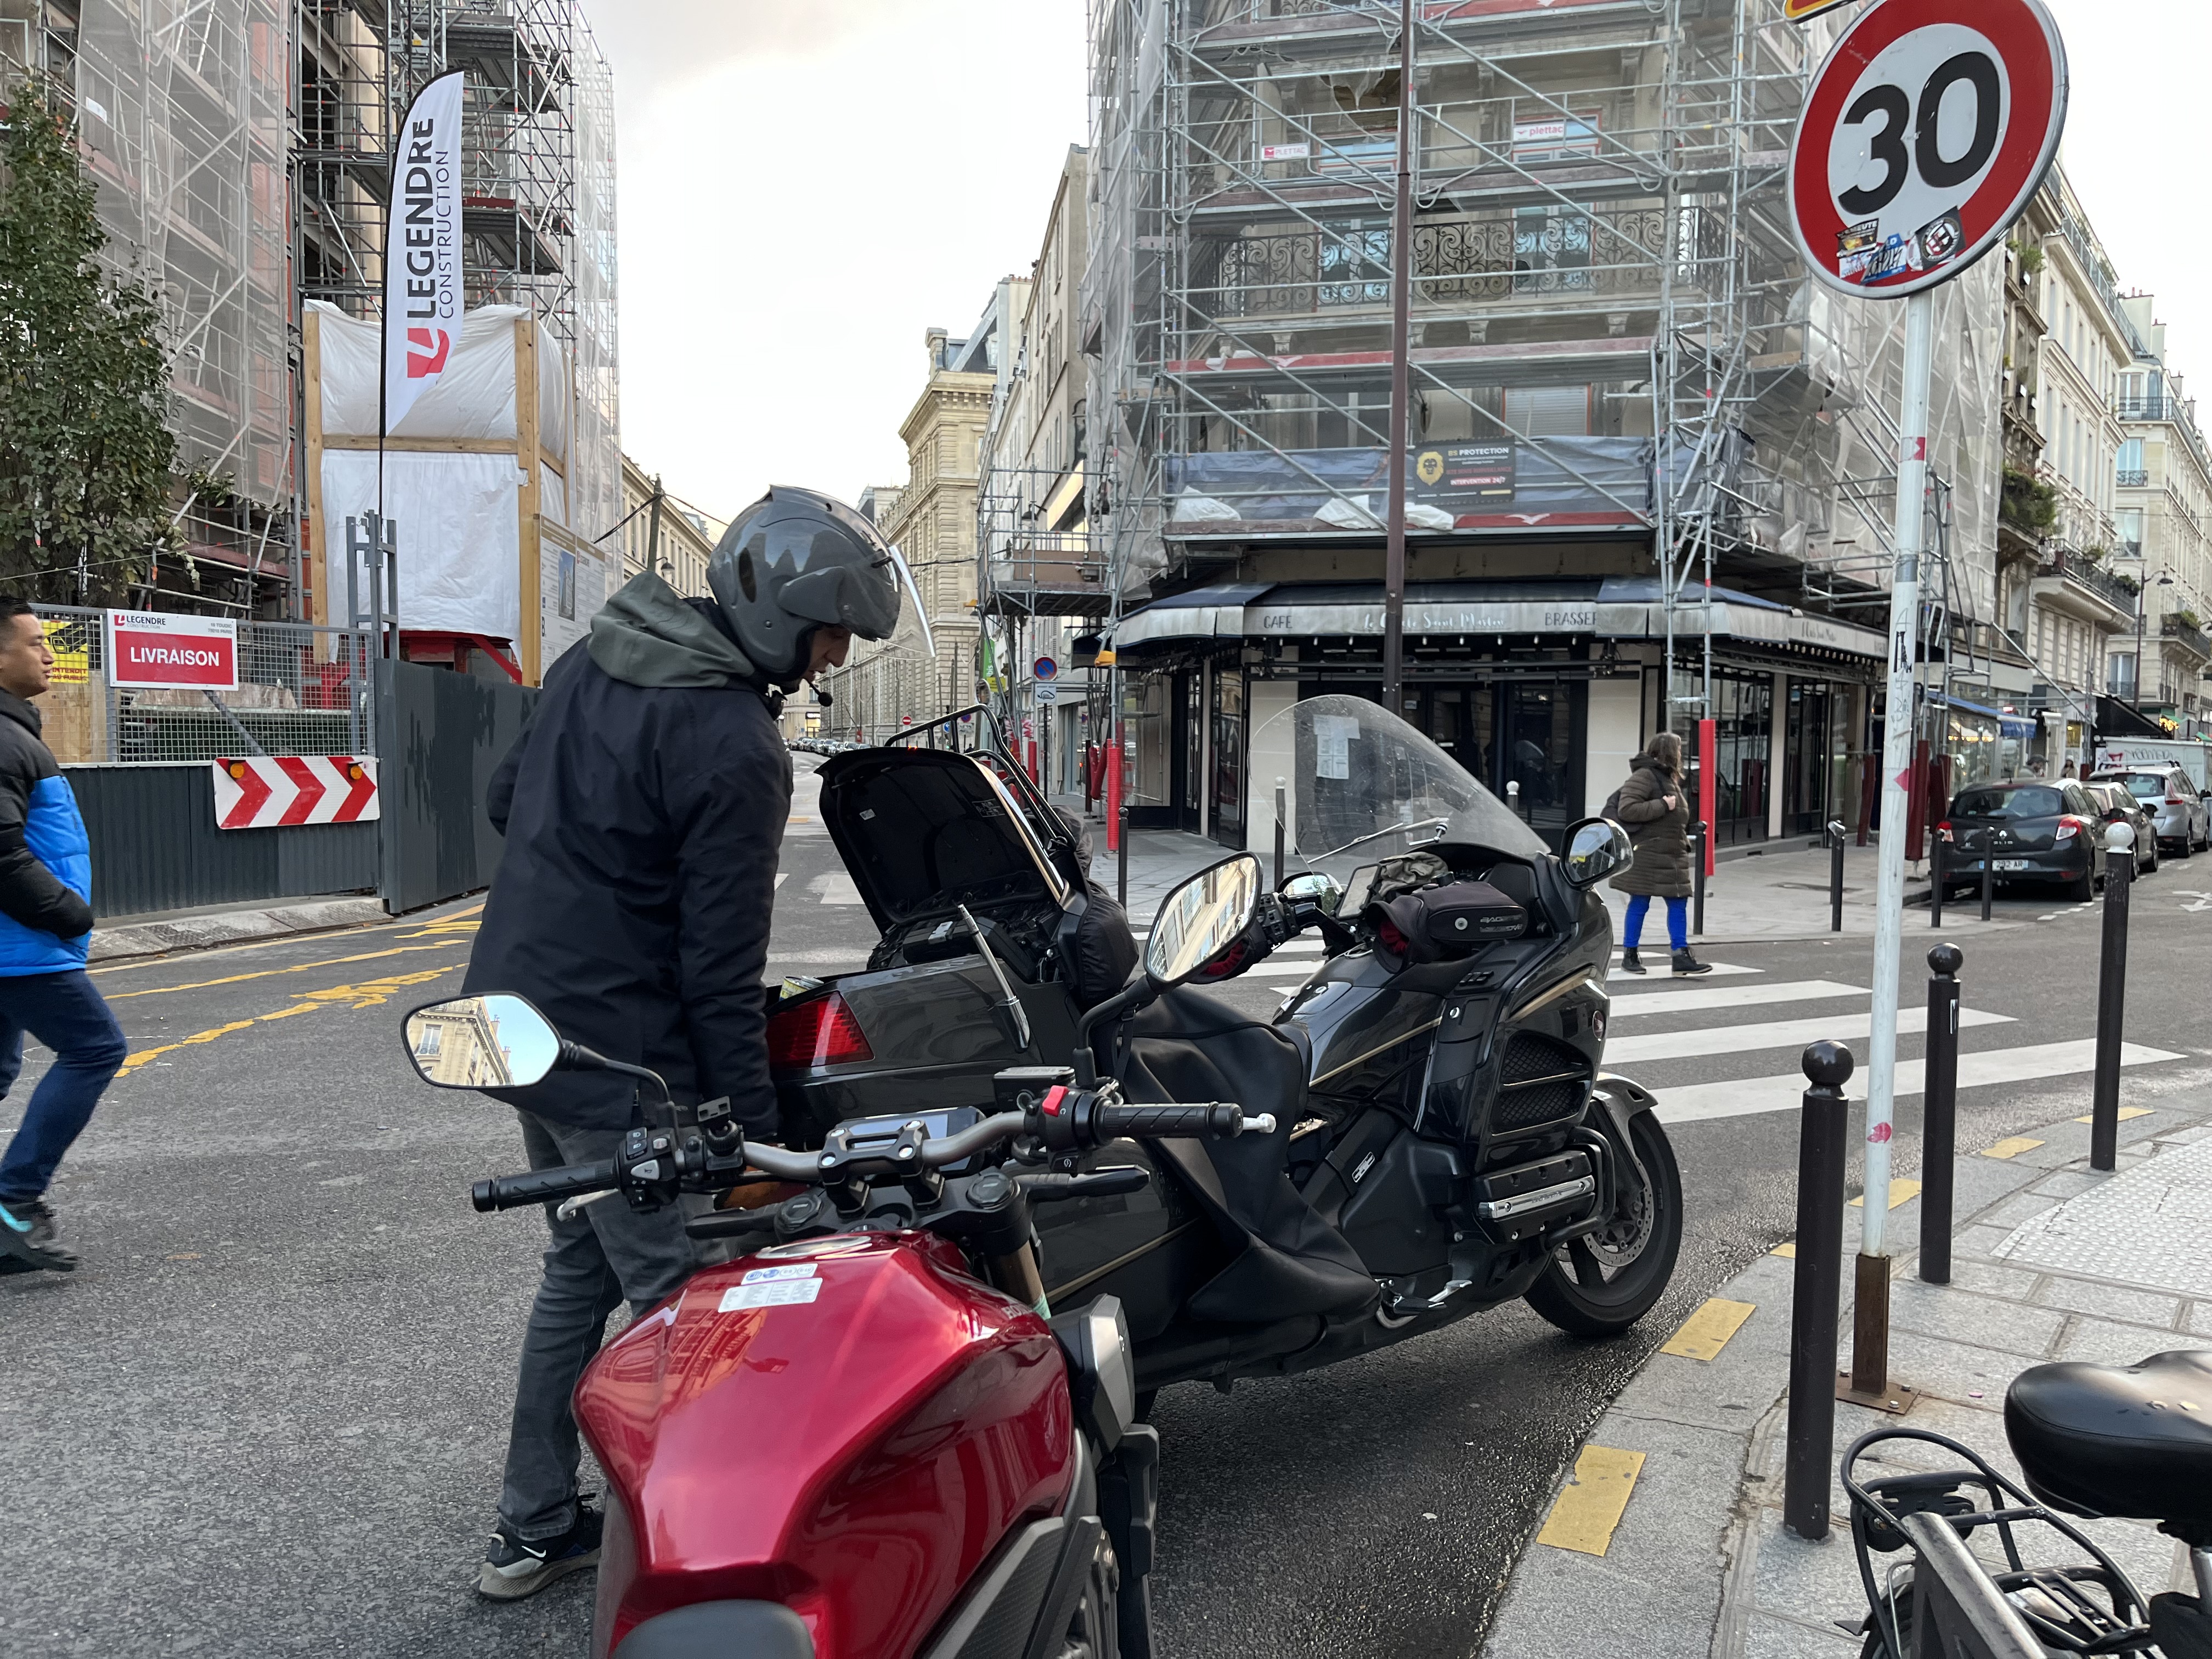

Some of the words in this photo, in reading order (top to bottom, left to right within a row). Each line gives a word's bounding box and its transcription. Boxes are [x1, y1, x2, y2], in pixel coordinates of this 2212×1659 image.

[1530, 126, 1563, 136] plettac
[1838, 51, 2001, 215] 30
[405, 118, 436, 318] LEGENDRE
[436, 150, 454, 319] CONSTRUCTION
[1459, 448, 1510, 456] PROTECTION
[127, 616, 166, 625] LEGENDRE
[1263, 615, 1293, 629] CAFE
[130, 646, 219, 667] LIVRAISON
